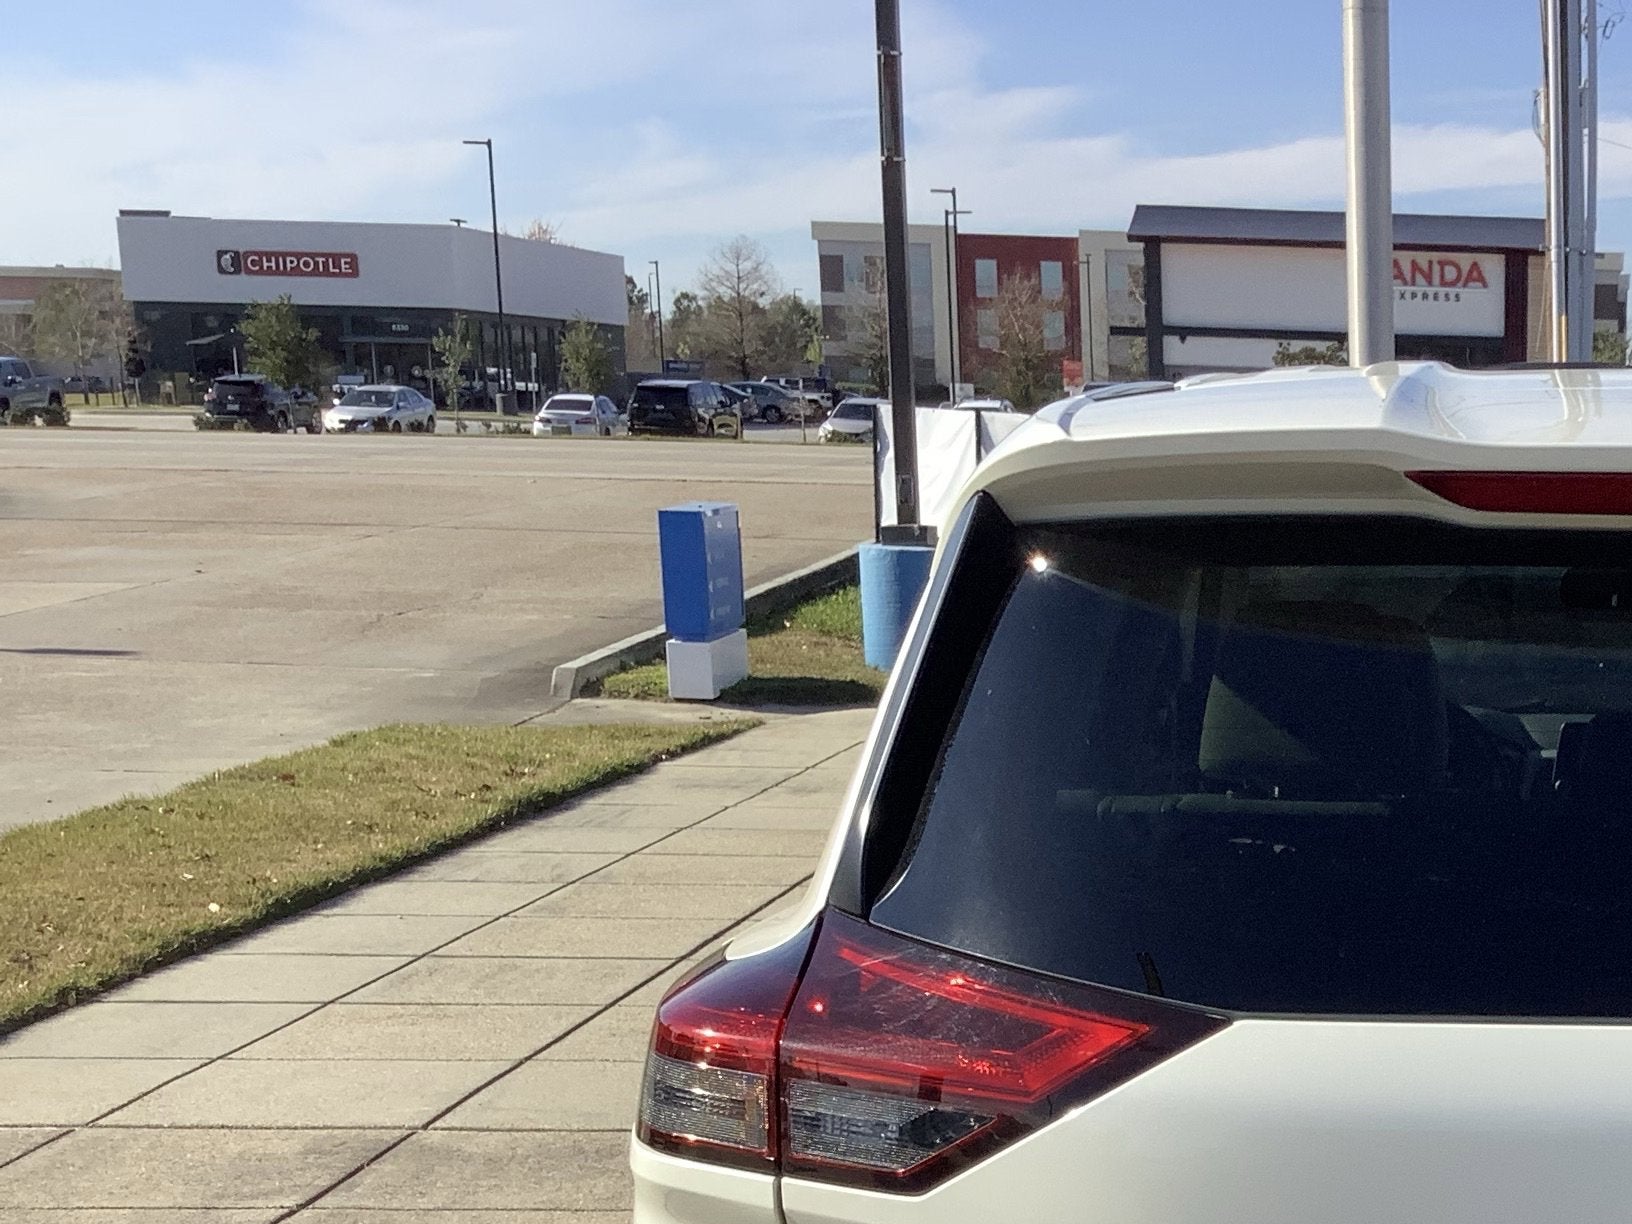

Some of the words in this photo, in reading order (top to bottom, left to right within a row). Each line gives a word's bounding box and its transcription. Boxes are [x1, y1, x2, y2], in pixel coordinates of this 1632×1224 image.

[247, 255, 353, 273] CHIPOTLE
[1393, 258, 1489, 288] ANDA
[1395, 290, 1462, 302] XPRESS
